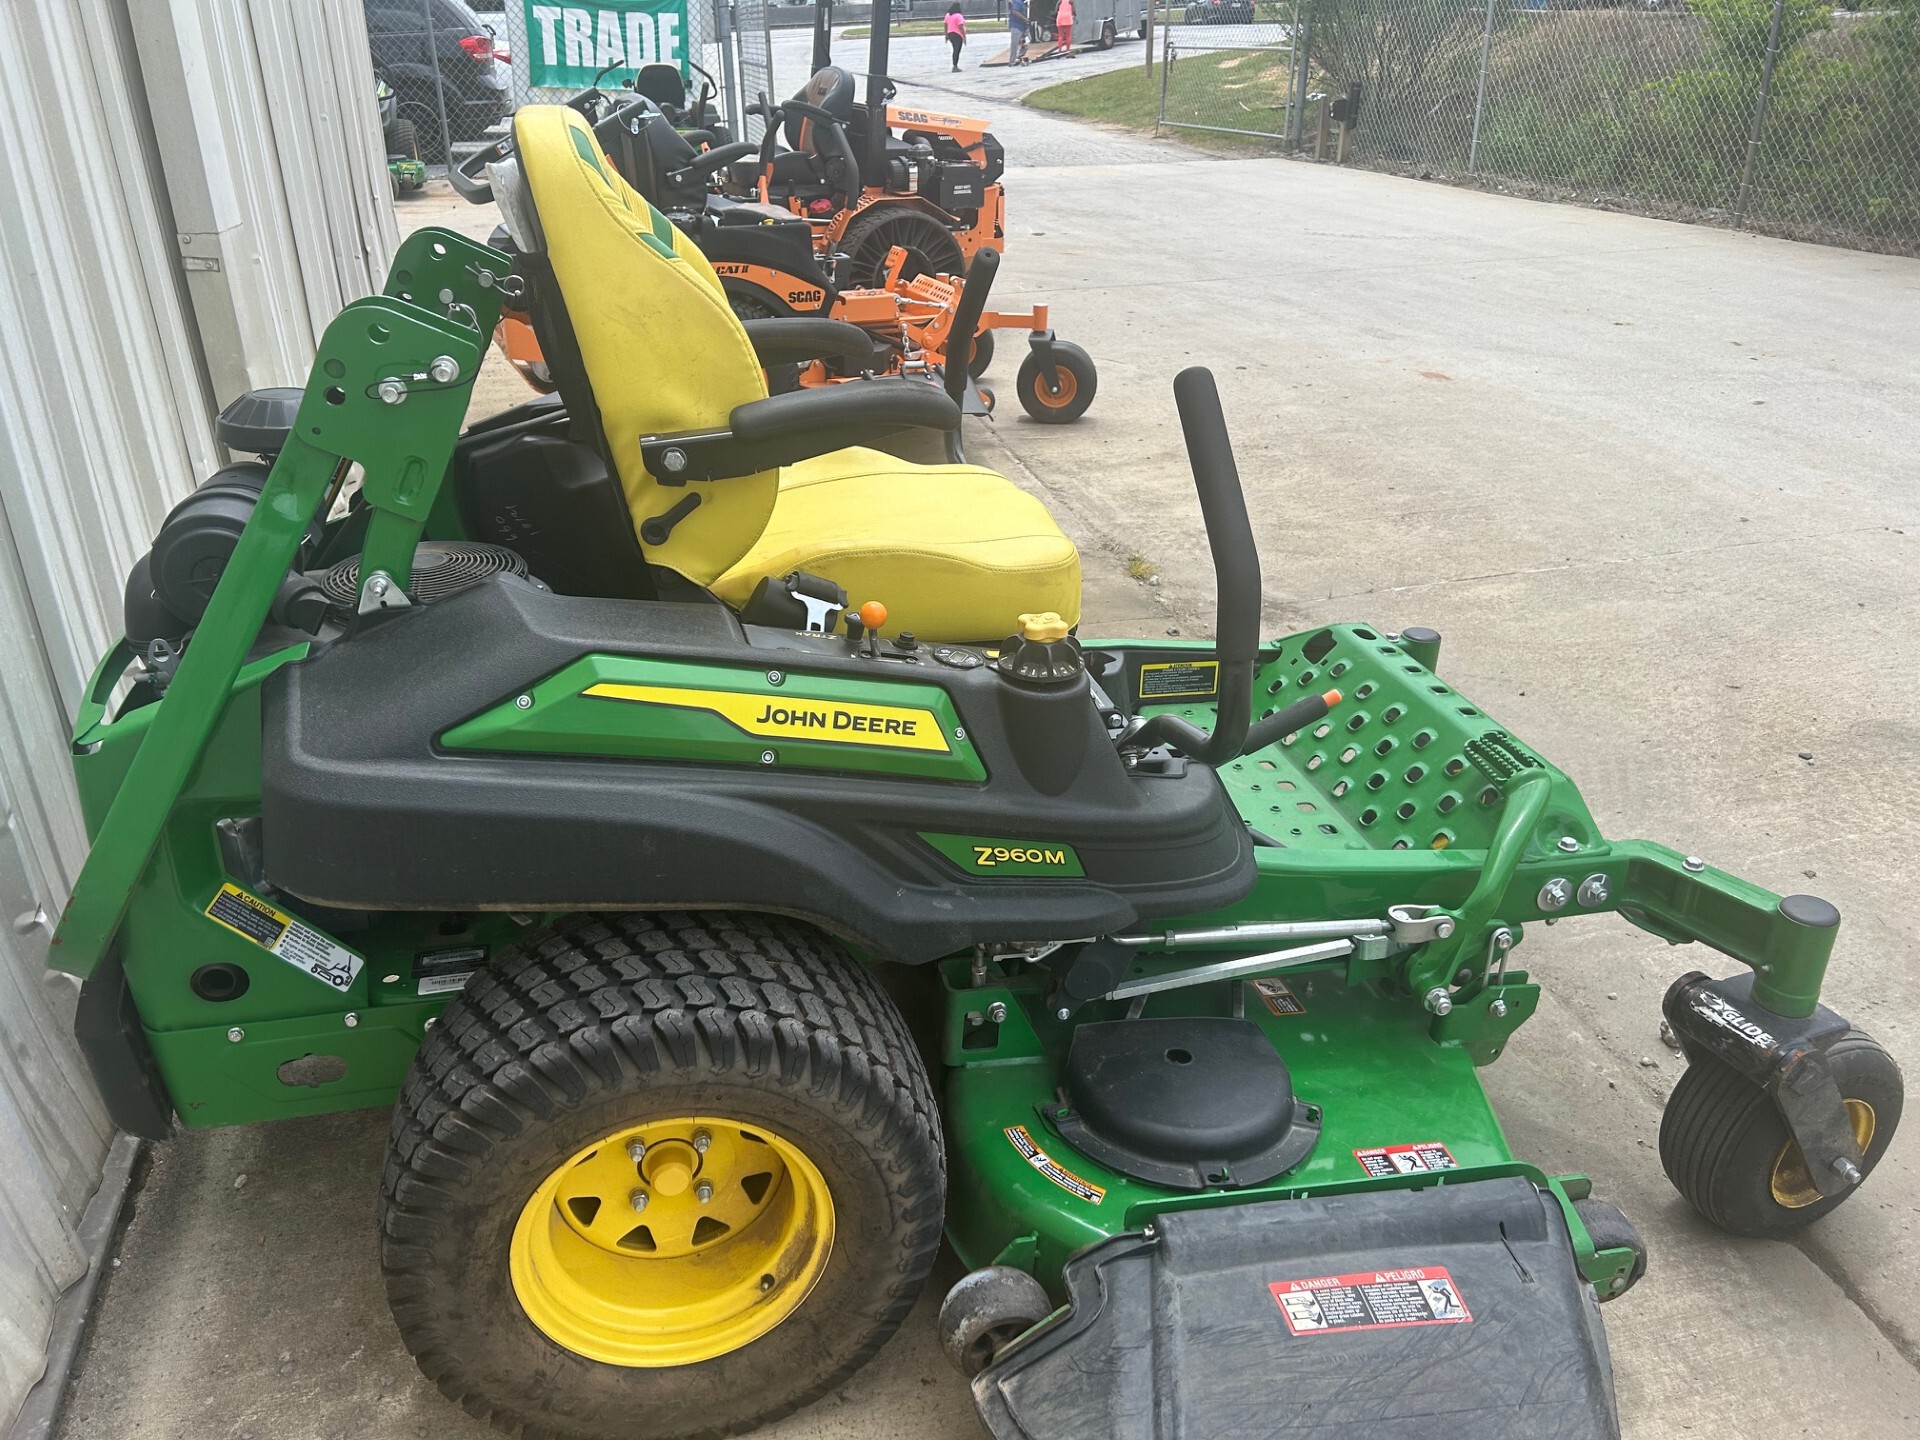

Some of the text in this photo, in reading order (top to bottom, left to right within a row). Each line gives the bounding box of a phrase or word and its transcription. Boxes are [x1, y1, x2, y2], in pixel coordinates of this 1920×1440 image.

[532, 5, 682, 70] TRADE
[897, 111, 928, 123] SCAG
[716, 265, 740, 275] CAT
[788, 290, 821, 304] SCAG
[756, 705, 917, 736] JOHN DEERE
[974, 846, 1066, 867] Z960M
[243, 895, 277, 918] CAUTION
[1300, 1270, 1426, 1290] DANGER PELIGRO
